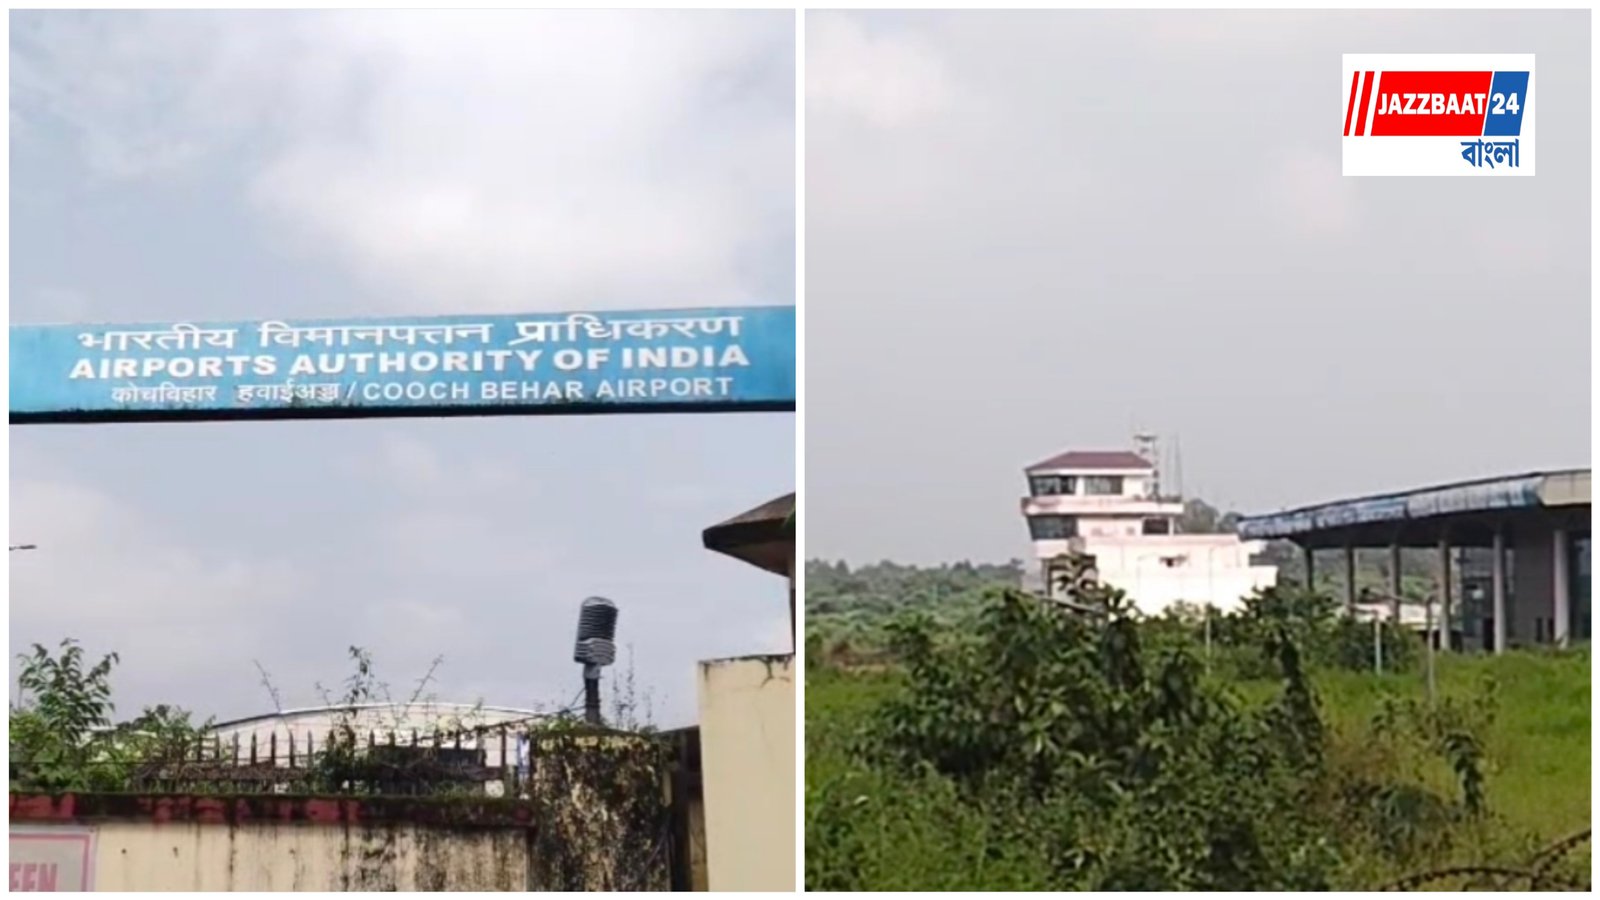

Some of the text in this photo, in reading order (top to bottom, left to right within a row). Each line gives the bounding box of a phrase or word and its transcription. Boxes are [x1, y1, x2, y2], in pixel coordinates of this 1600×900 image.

[76, 313, 744, 351] भारतीय विमानपत्तन प्राधिकरण
[68, 345, 749, 379] AIRPORTS AUTHORITY OF INDIA
[110, 382, 218, 404] कोचविहार
[362, 381, 470, 401] COOCH
[480, 381, 584, 400] BEHAR
[595, 376, 734, 398] AIRPORT
